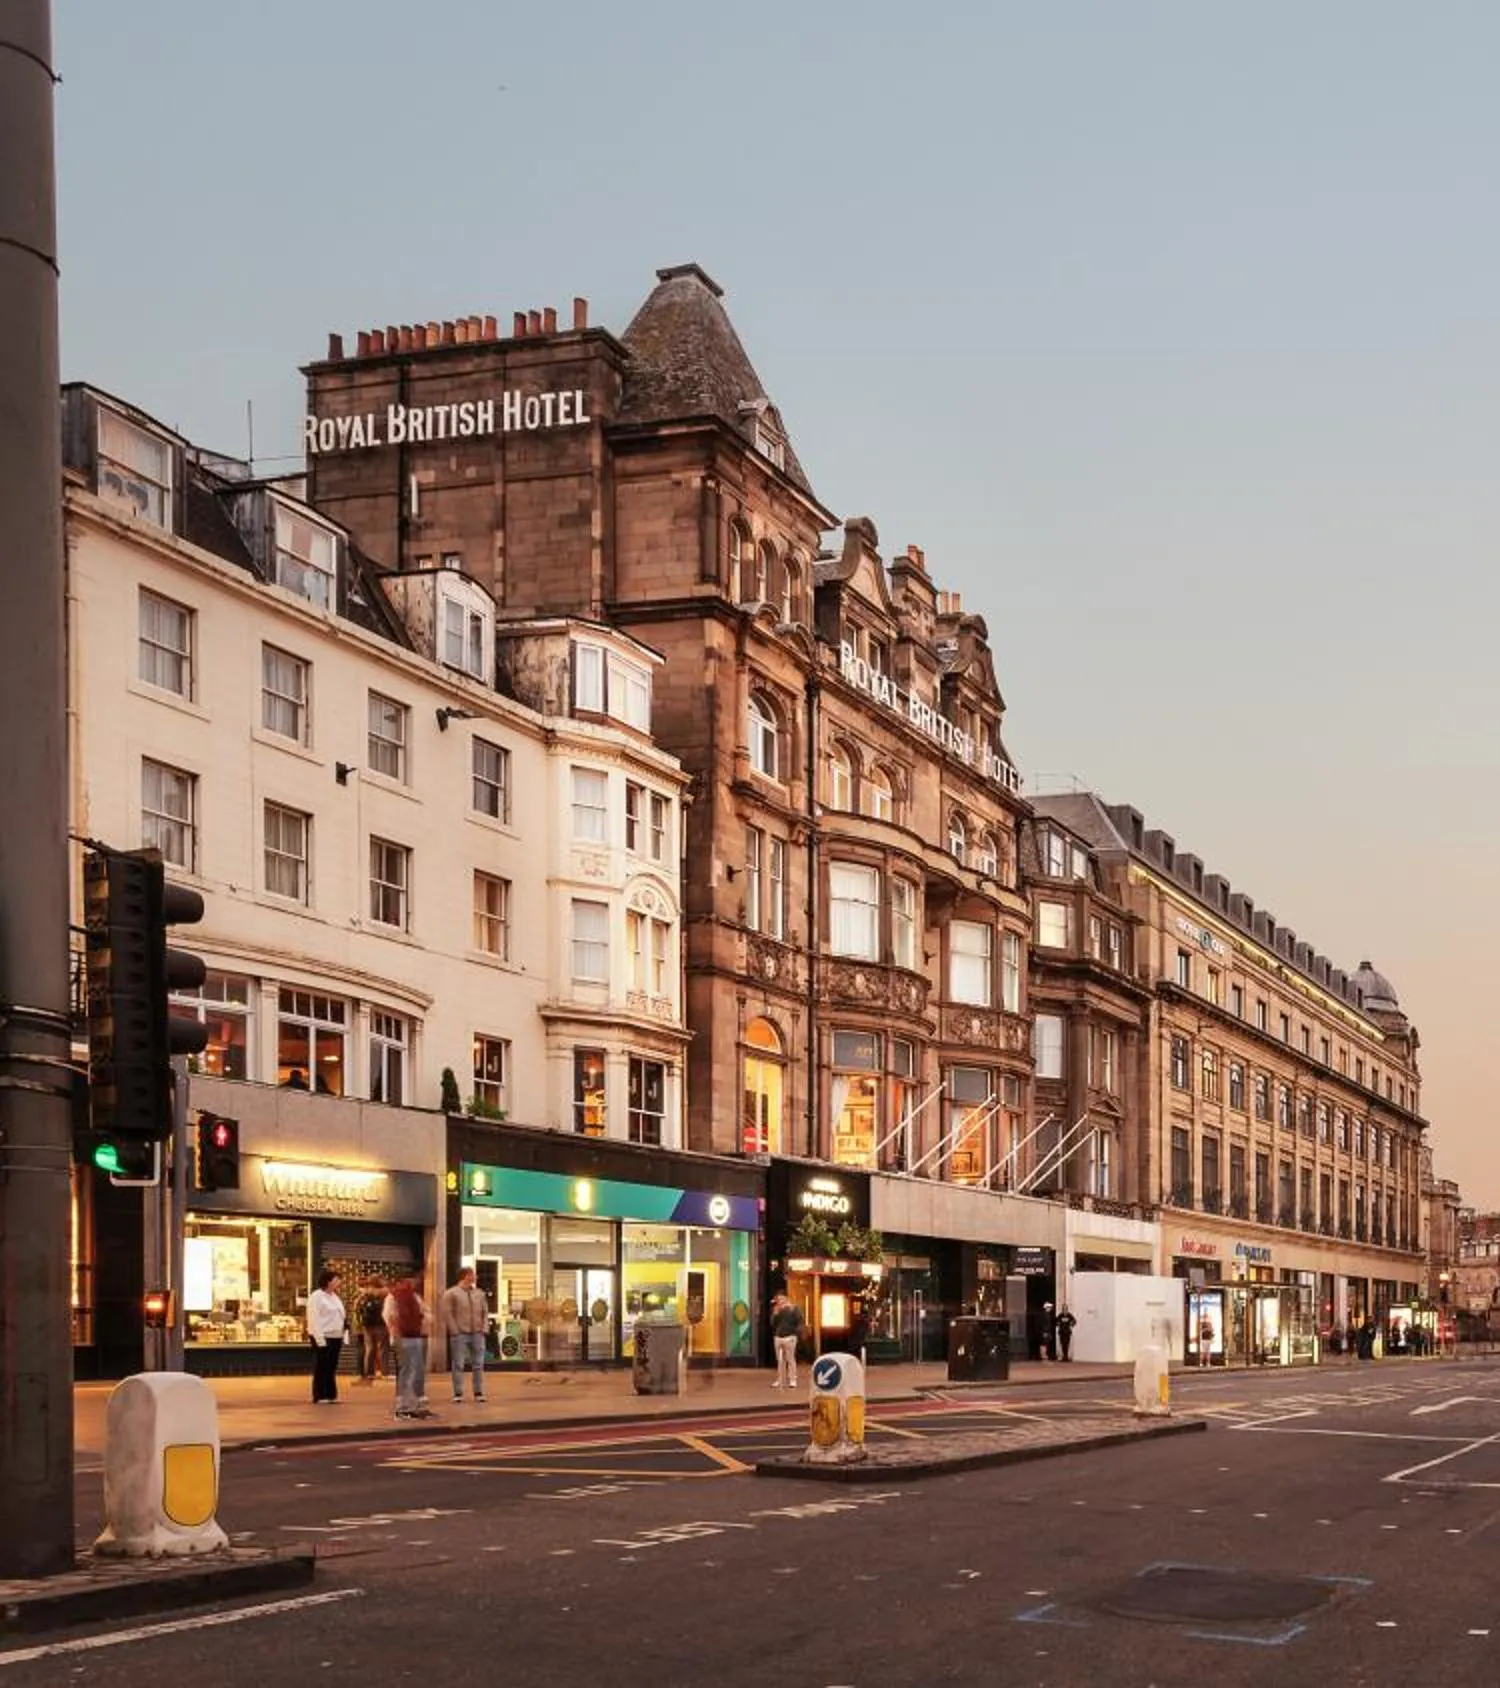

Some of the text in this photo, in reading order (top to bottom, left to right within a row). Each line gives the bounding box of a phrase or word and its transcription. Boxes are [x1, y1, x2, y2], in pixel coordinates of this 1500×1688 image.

[303, 389, 591, 453] ROYAL BRITISH HOTEL
[840, 640, 903, 715] ROYAL
[909, 689, 974, 766] BRITISH
